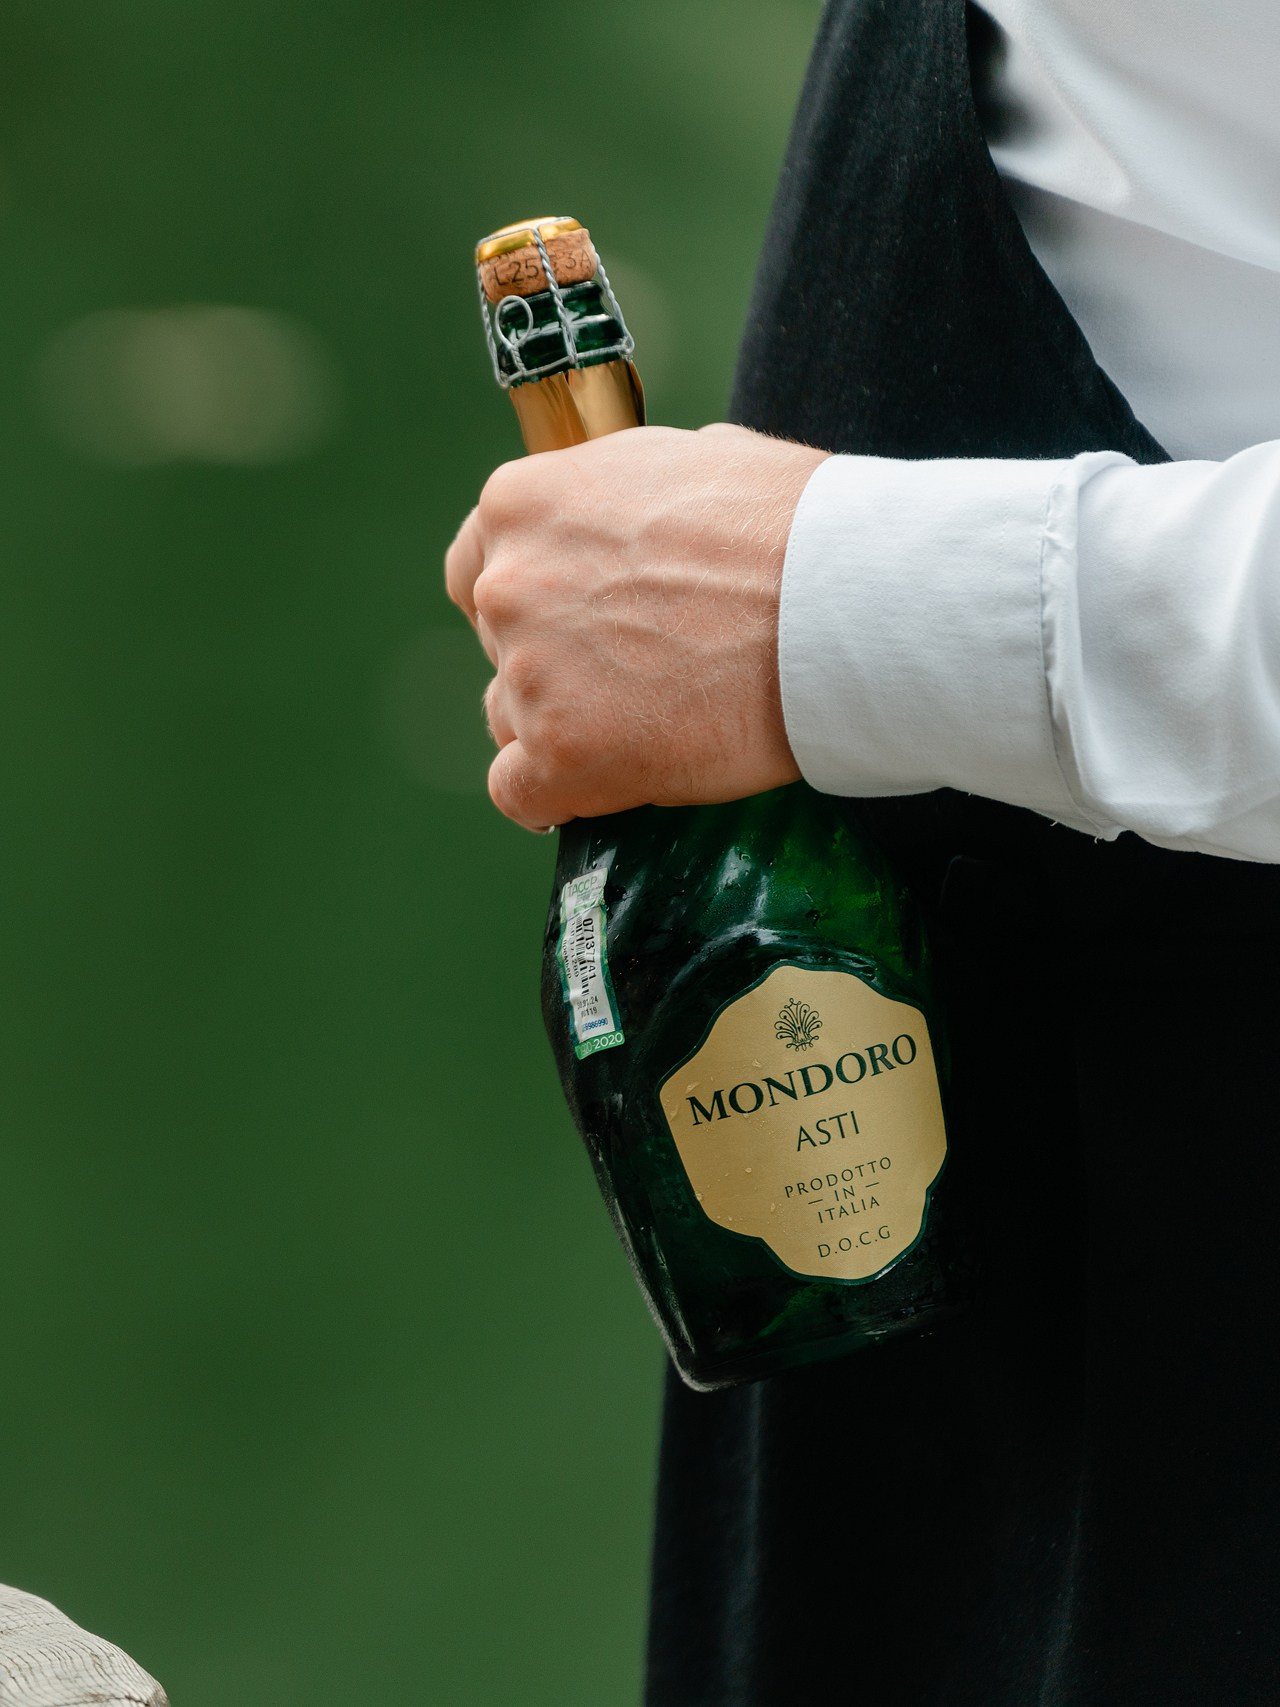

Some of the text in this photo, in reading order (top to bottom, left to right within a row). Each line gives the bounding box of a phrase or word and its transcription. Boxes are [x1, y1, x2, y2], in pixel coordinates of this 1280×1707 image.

[582, 918, 597, 979] 07137741
[686, 1034, 917, 1126] MONDORO
[796, 1110, 860, 1152] ASTI
[784, 1156, 892, 1198] PRODOTTO
[834, 1185, 856, 1202] IN
[817, 1196, 880, 1223] ITALIA
[817, 1225, 892, 1258] D.O.C.G
